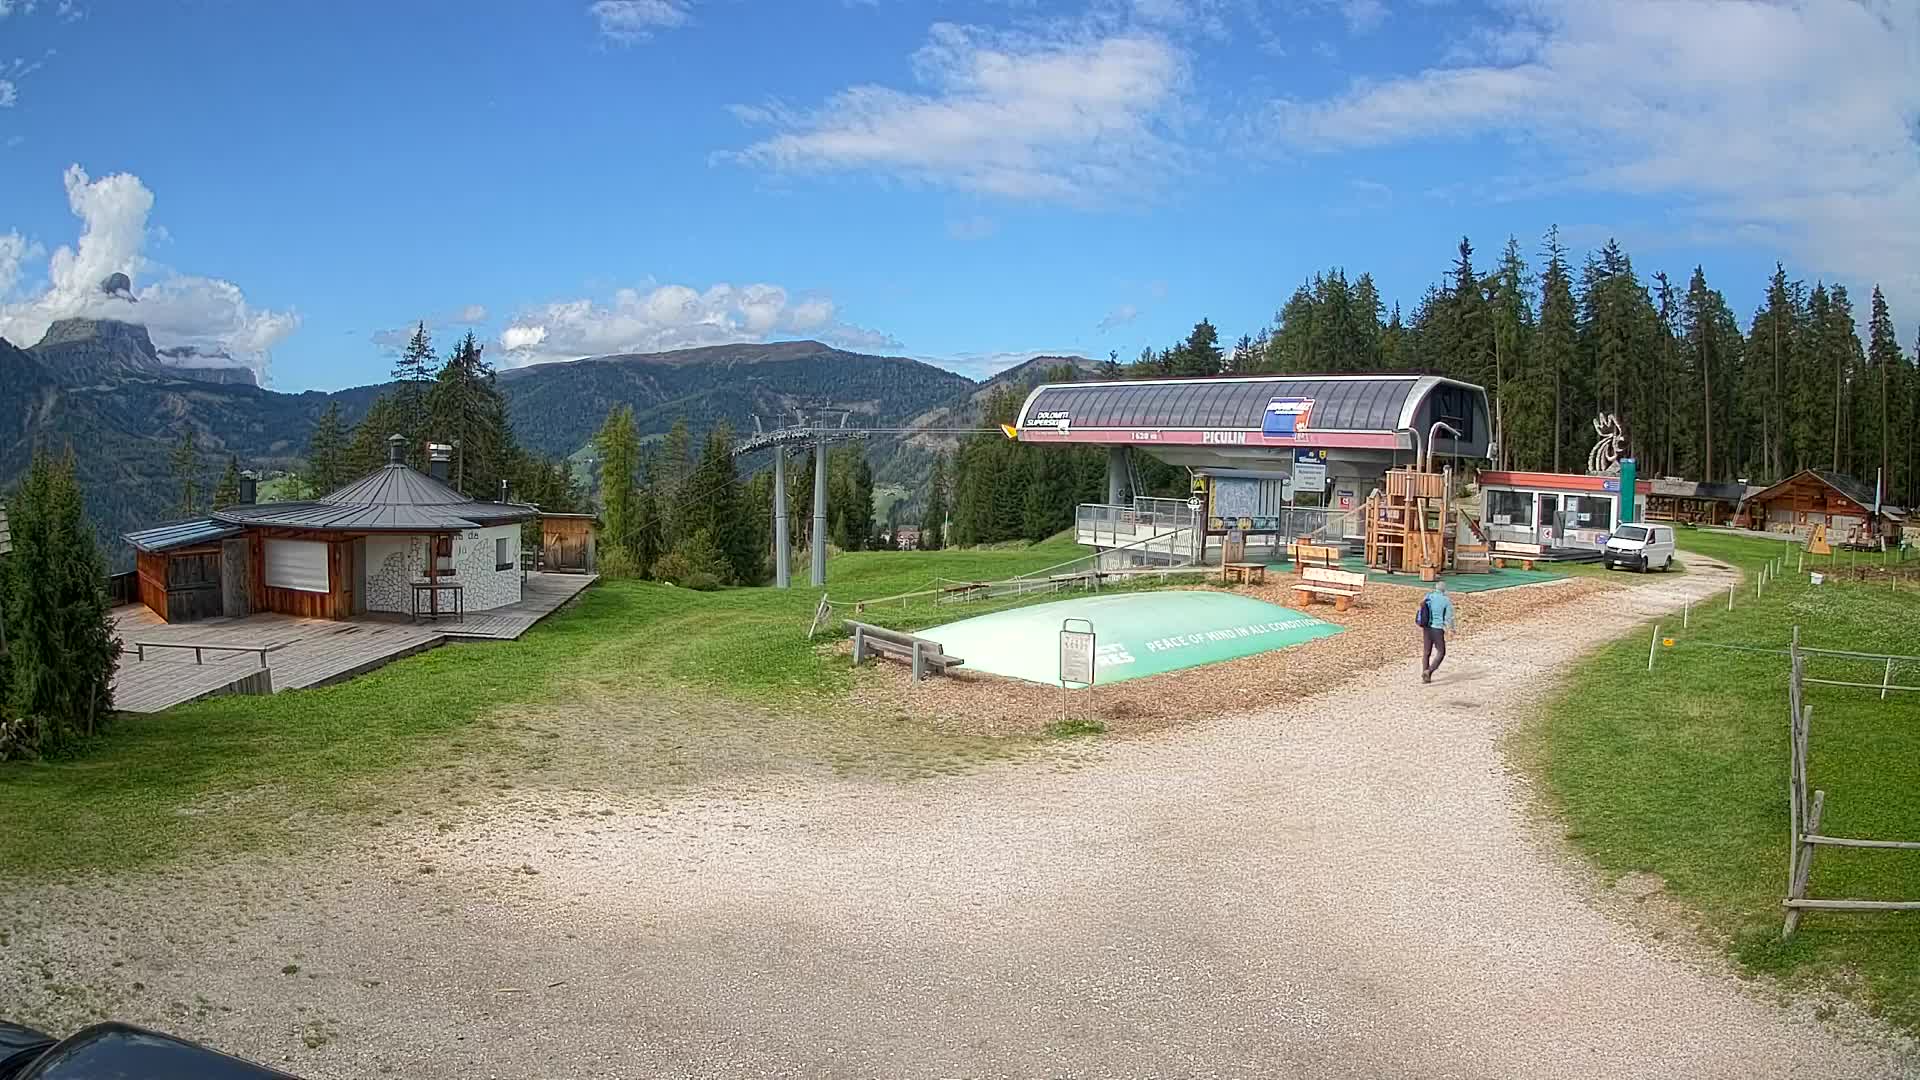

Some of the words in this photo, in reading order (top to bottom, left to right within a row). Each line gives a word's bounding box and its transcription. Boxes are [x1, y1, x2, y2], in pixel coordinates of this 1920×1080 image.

[1202, 431, 1246, 444] PICULIN
[1145, 635, 1189, 652] PEACE
[1189, 632, 1206, 644] OF
[1206, 628, 1236, 642] MIND
[1234, 627, 1249, 638] IN
[1249, 624, 1270, 636] ALL
